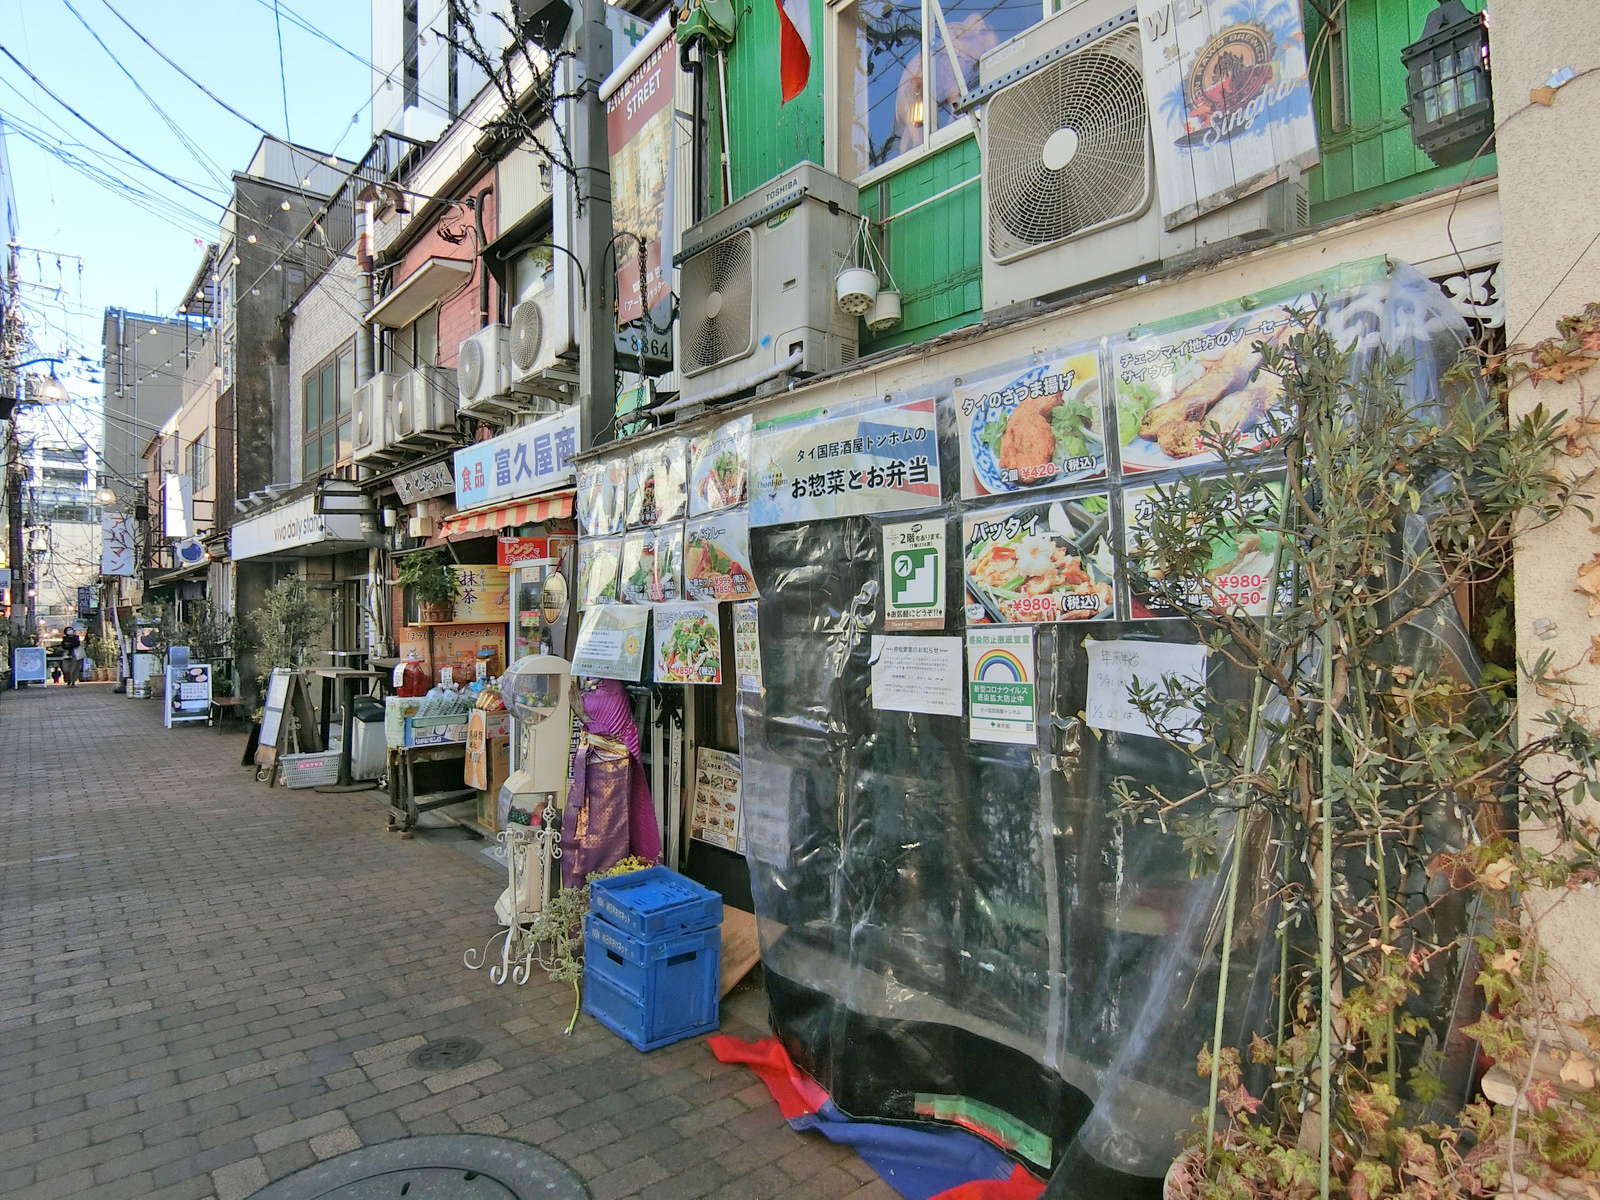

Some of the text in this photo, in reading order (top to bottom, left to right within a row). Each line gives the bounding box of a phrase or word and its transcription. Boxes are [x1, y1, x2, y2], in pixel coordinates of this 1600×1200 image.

[626, 68, 662, 121] STREET
[1202, 78, 1297, 148] Singha
[766, 178, 798, 202] TOSHIBA
[1121, 361, 1176, 385] サイウア
[962, 370, 1075, 416] タイのさつま揚げ
[494, 425, 577, 487] 富久屋商
[797, 426, 927, 463] タイ国居酒屋トンホムの
[462, 461, 485, 493] 食品
[791, 456, 930, 499] お惣菜とお弁当
[1001, 455, 1097, 482] 2個 ¥420- (税込)
[274, 523, 287, 542] vivo
[287, 517, 302, 540] daily
[900, 532, 943, 544] 2階もあります。
[971, 514, 1040, 542] パッタイ
[110, 516, 126, 572] アパマン
[460, 571, 478, 605] 抹茶
[1217, 574, 1268, 590] ¥980-
[890, 608, 939, 618] お気軽にどうぞ!!
[1013, 594, 1100, 612] ¥980- (税込)
[969, 634, 1030, 645] 感染防止徹底宣言
[675, 666, 698, 675] ¥850-
[974, 684, 1028, 695] 新型コロナウイルス
[977, 693, 1025, 703] 感染拡大防止中
